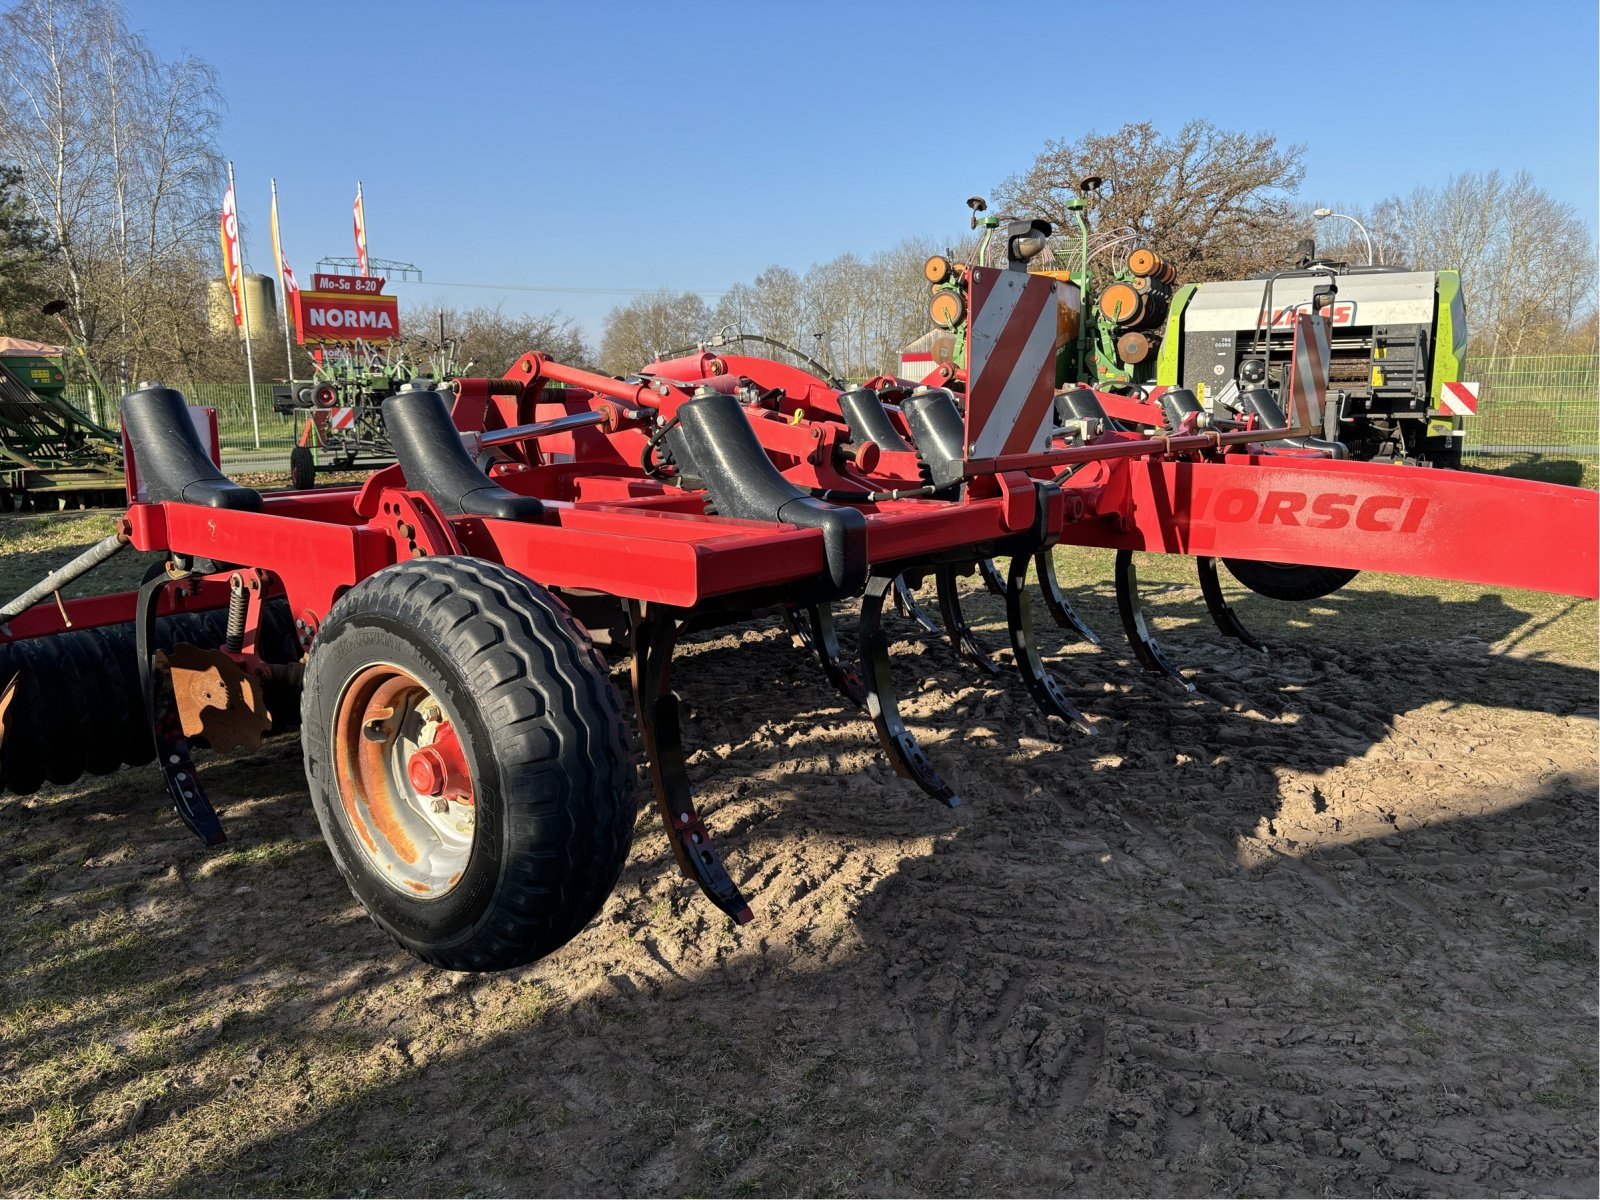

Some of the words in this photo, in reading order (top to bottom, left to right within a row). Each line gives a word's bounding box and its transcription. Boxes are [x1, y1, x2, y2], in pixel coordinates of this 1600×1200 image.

[320, 277, 350, 290] Mo-Sa
[355, 280, 377, 292] 8-20
[309, 307, 393, 329] NORMA
